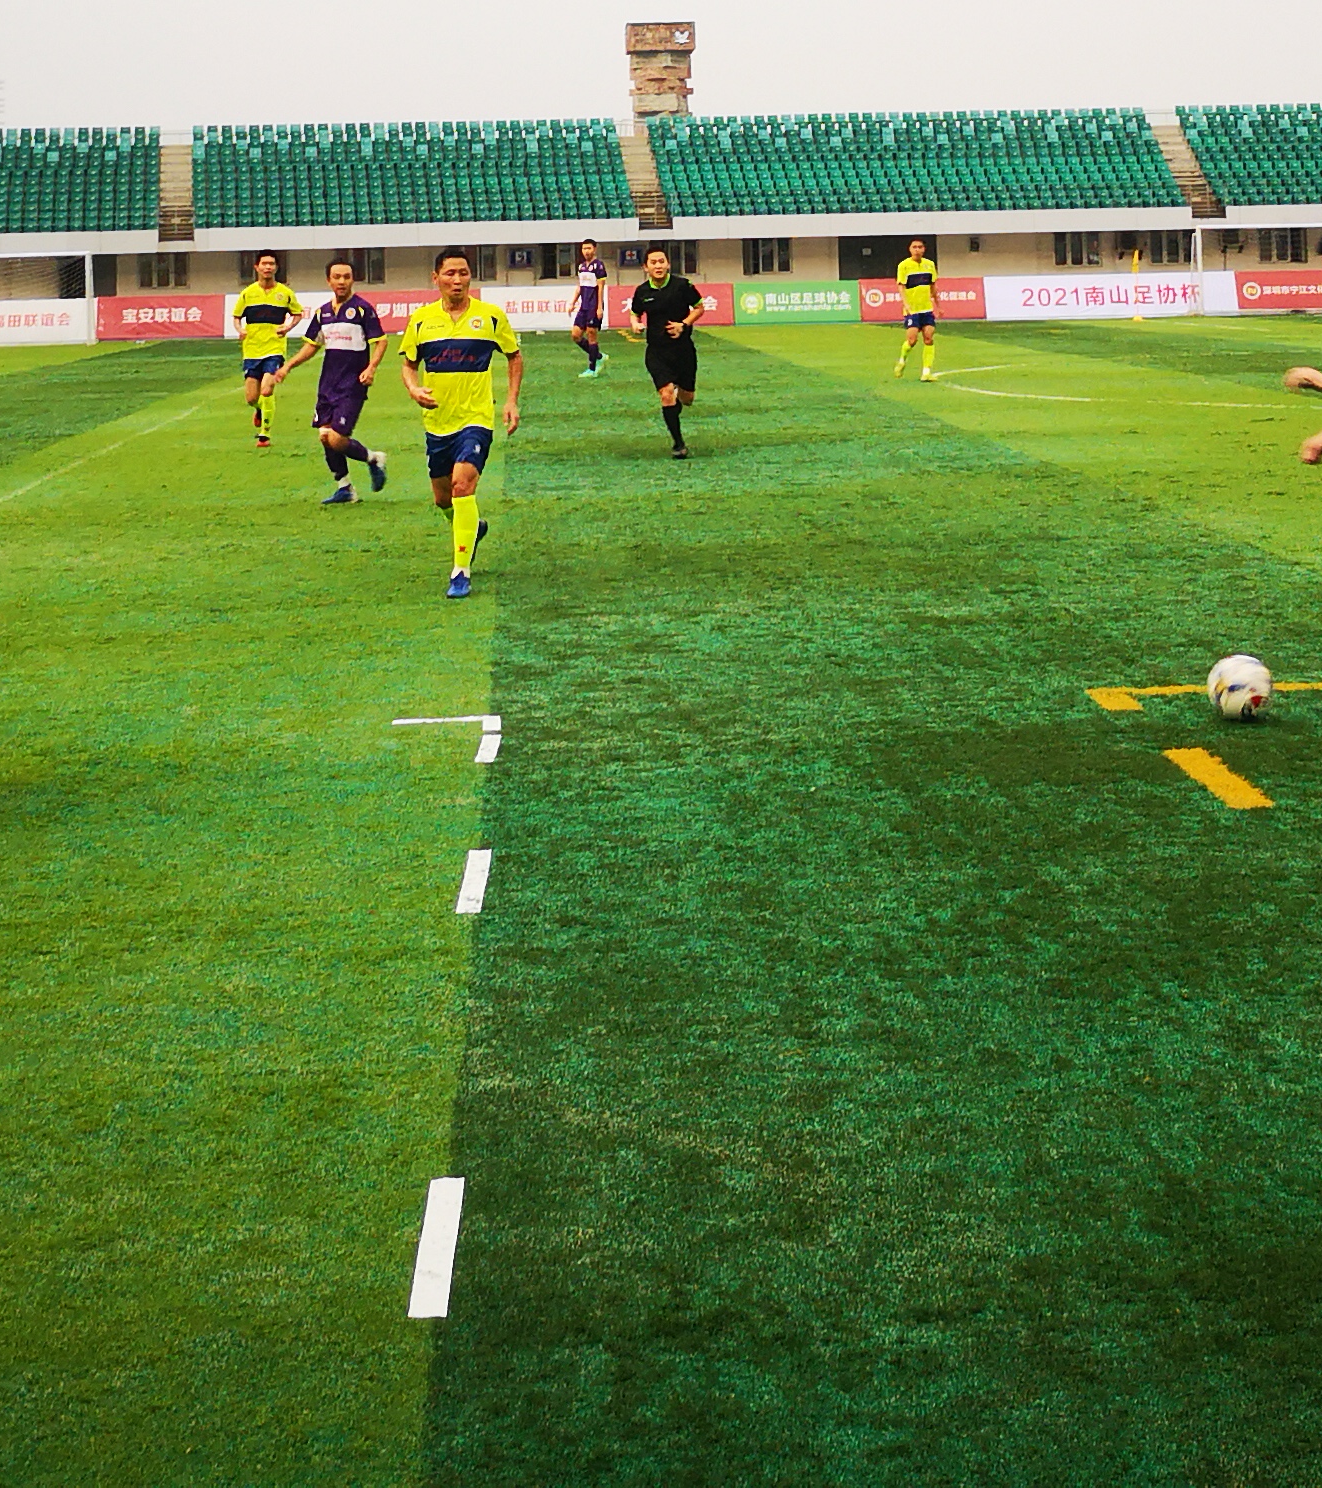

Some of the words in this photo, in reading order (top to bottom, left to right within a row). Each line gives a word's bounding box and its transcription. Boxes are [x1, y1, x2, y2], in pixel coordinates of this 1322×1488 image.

[765, 291, 851, 305] 南山区足球协会
[122, 306, 202, 323] 宝安联谊会
